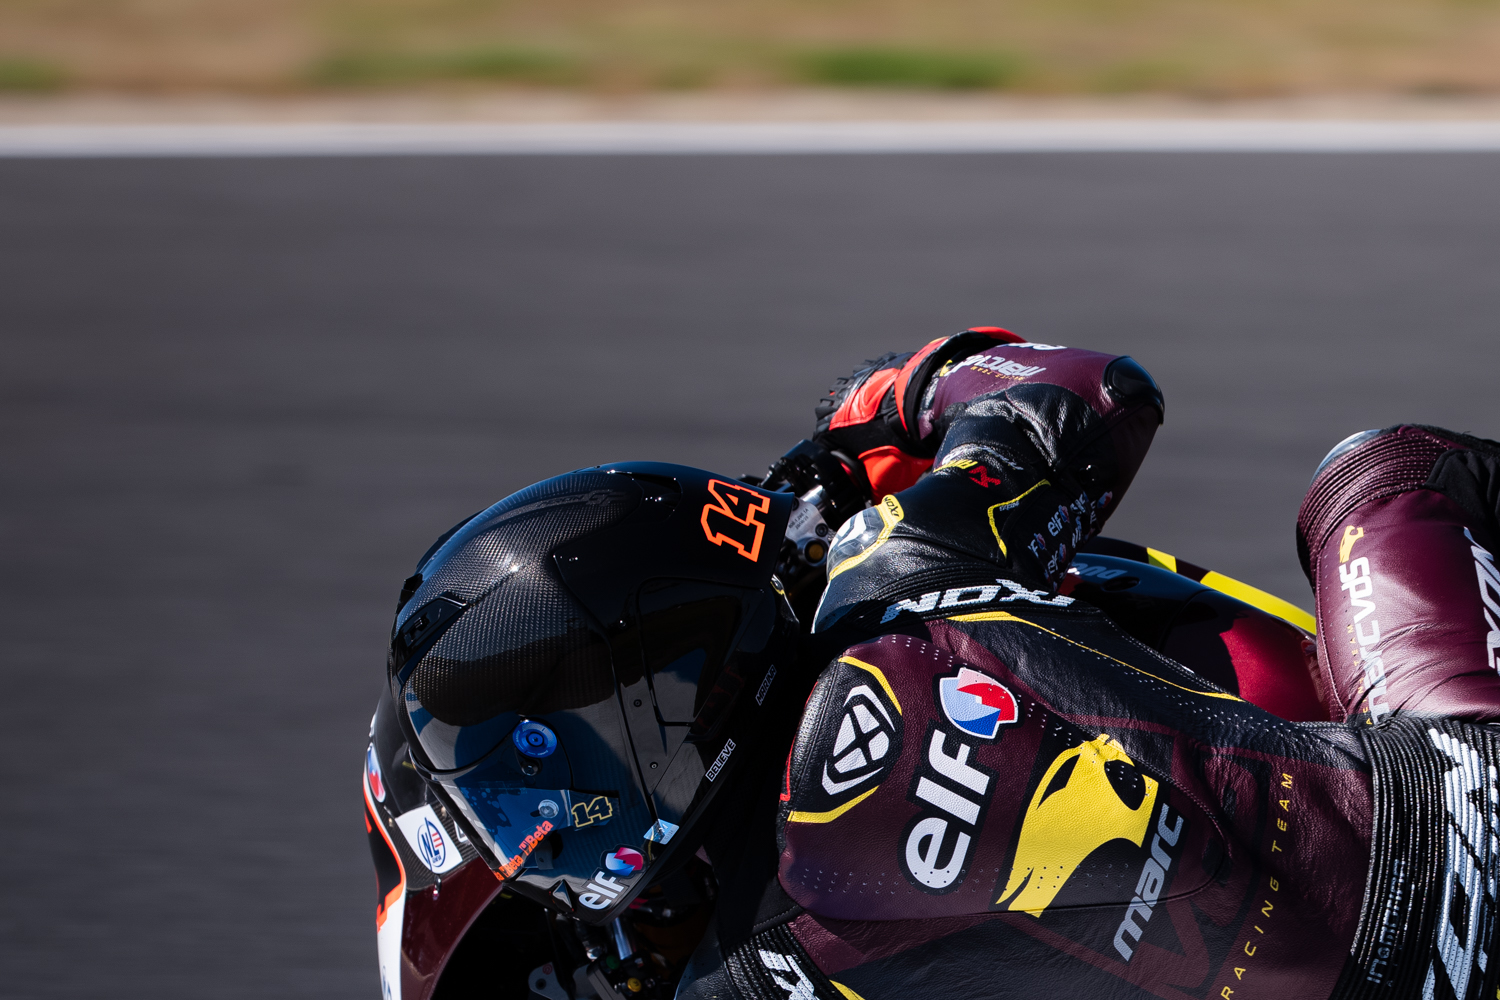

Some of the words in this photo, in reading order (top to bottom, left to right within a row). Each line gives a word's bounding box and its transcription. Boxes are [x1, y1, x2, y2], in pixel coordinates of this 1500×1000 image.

[701, 479, 770, 562] 14
[1047, 511, 1063, 537] elf
[880, 578, 1076, 624] IXON
[755, 664, 777, 706] MARINA
[706, 738, 736, 782] BELIEVE
[571, 795, 613, 828] 14
[906, 730, 990, 889] elf
[578, 871, 624, 910] elf
[1113, 803, 1184, 961] marc
[1221, 876, 1280, 1000] RACING
[1272, 772, 1293, 853] TEAM
